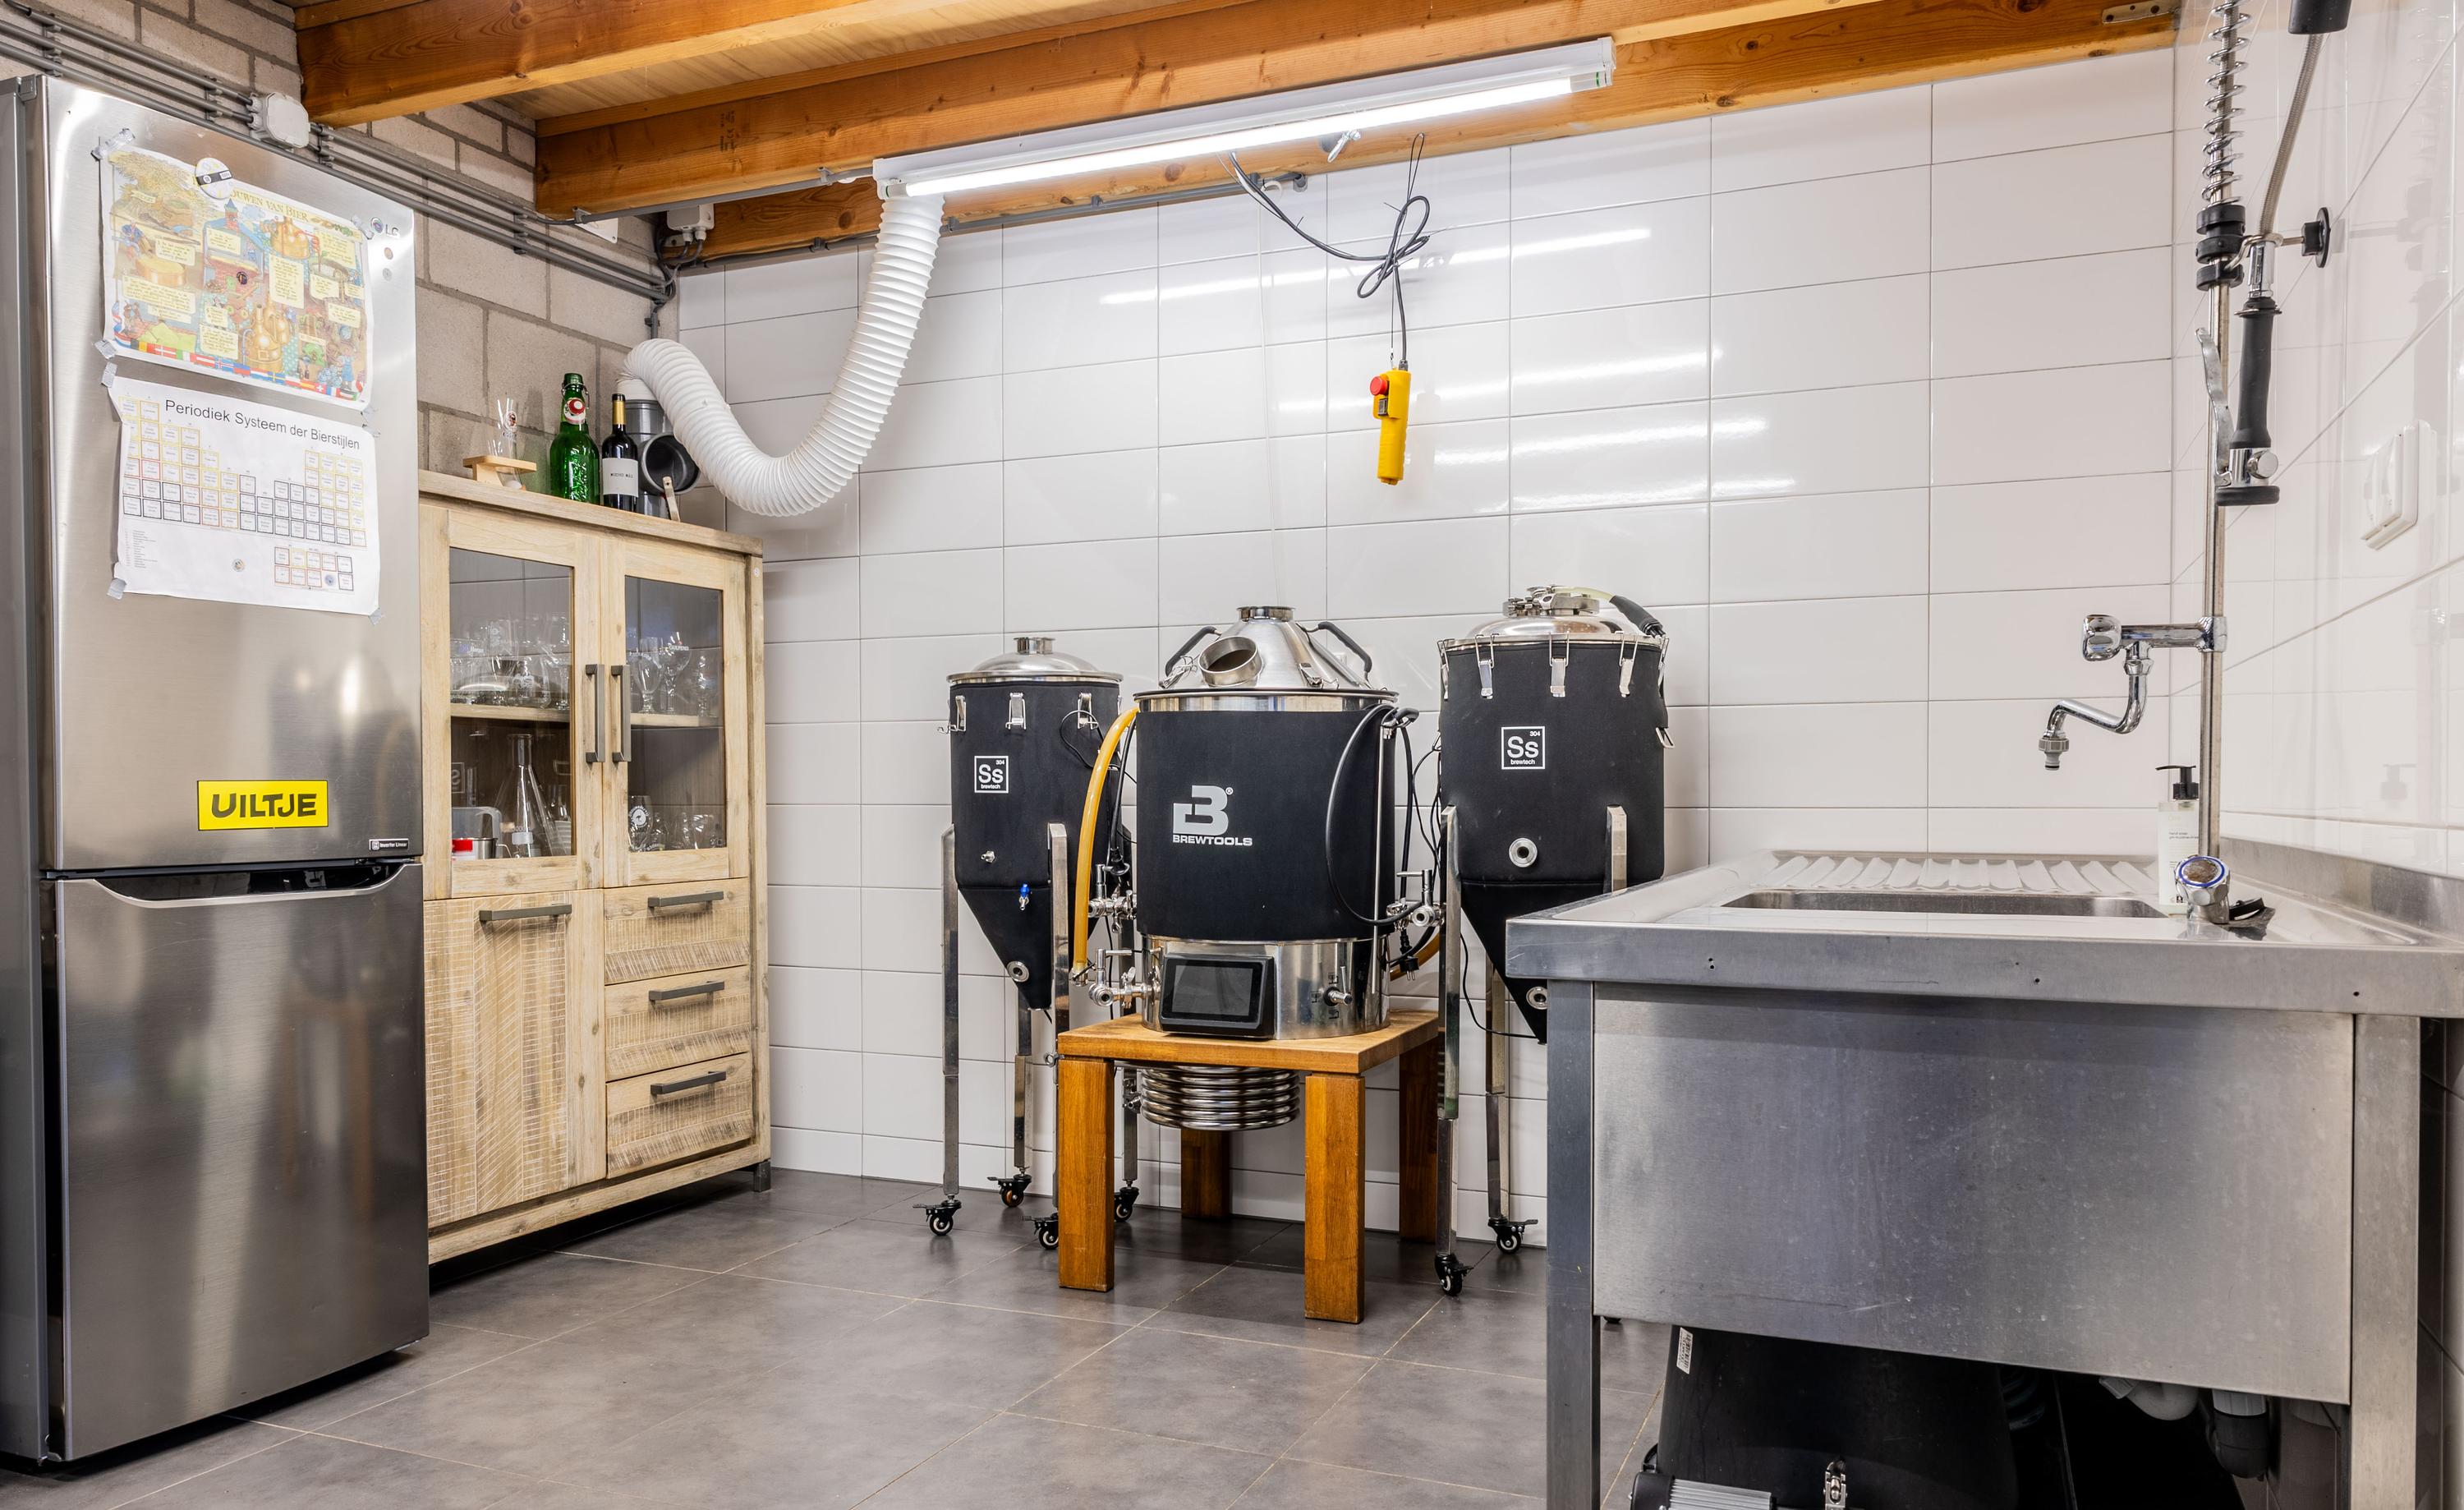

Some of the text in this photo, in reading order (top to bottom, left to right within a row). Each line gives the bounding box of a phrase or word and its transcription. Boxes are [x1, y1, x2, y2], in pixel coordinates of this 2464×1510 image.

[385, 223, 400, 237] LG
[165, 399, 361, 450] Periodiek Systeem der Bierstijlen
[1507, 736, 1538, 758] Ss
[978, 764, 1004, 783] Ss
[211, 792, 318, 819] UILTJE
[1172, 835, 1253, 846] BREWTOOLS
